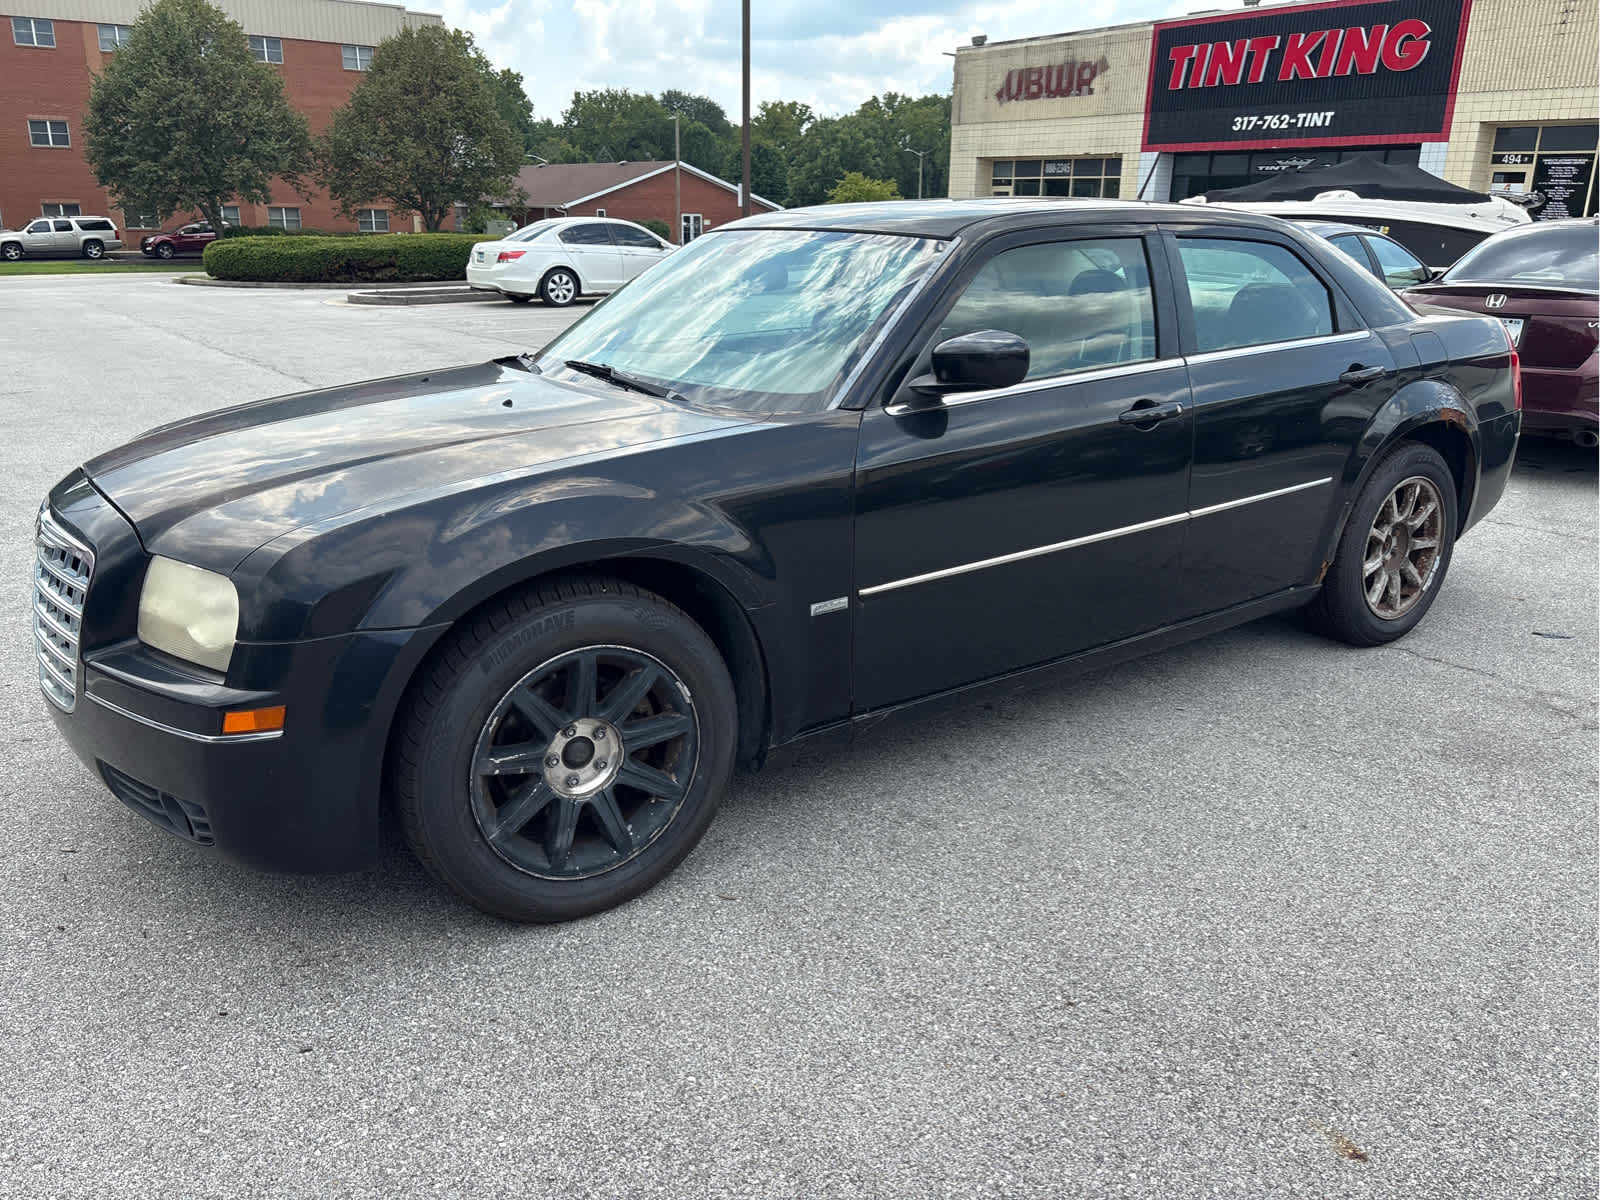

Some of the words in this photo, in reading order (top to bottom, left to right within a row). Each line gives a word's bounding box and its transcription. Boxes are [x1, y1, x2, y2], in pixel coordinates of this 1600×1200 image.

[1168, 35, 1280, 90] TINT
[1278, 18, 1431, 81] KING
[1232, 111, 1335, 131] 317-762-TINT
[1502, 154, 1521, 164] 494
